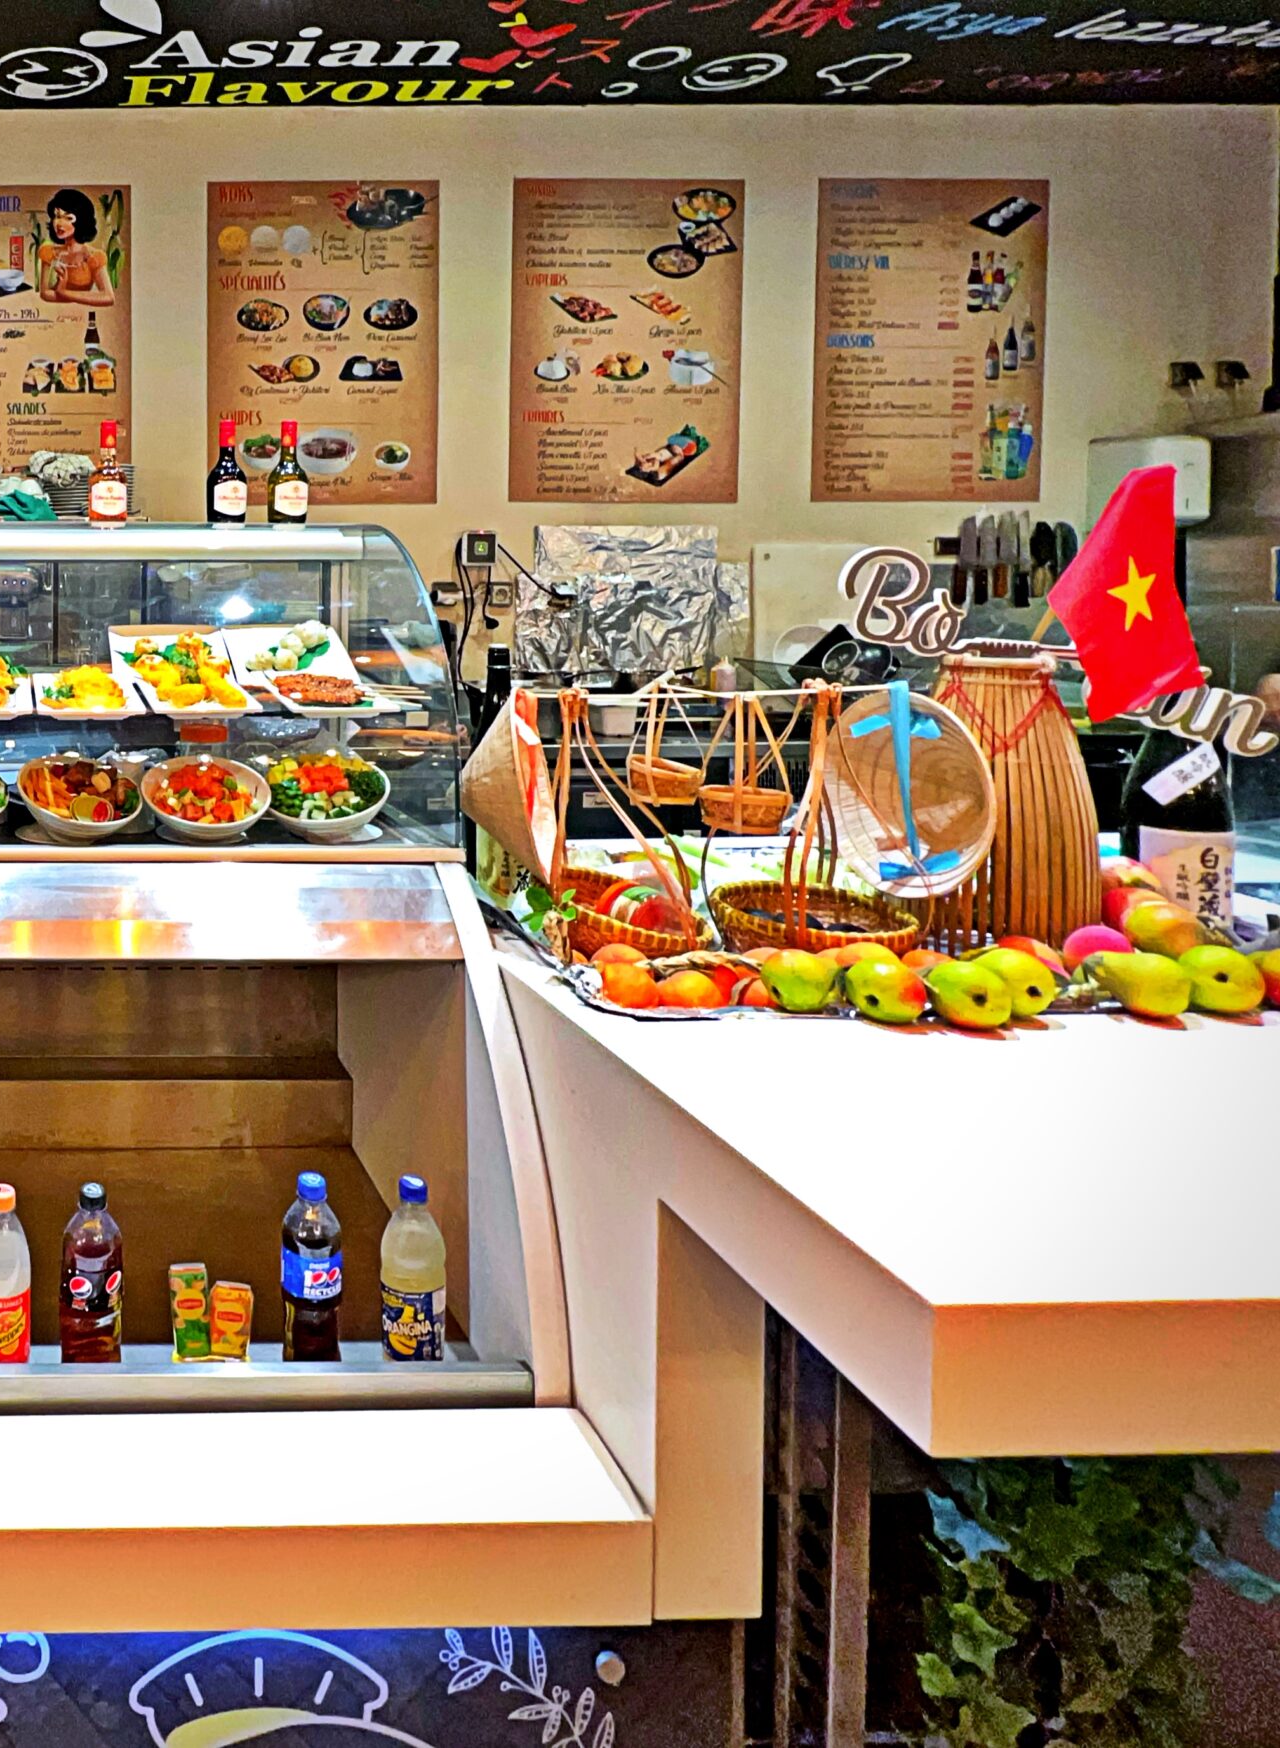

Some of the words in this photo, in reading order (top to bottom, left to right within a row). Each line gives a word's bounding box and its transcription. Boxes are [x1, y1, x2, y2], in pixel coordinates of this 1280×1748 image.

[129, 27, 461, 69] Asian
[119, 72, 515, 106] Flavour
[218, 269, 287, 292] SPÉCIALITÉS
[6, 402, 47, 416] SALADES
[382, 1313, 433, 1336] ORANGINA
